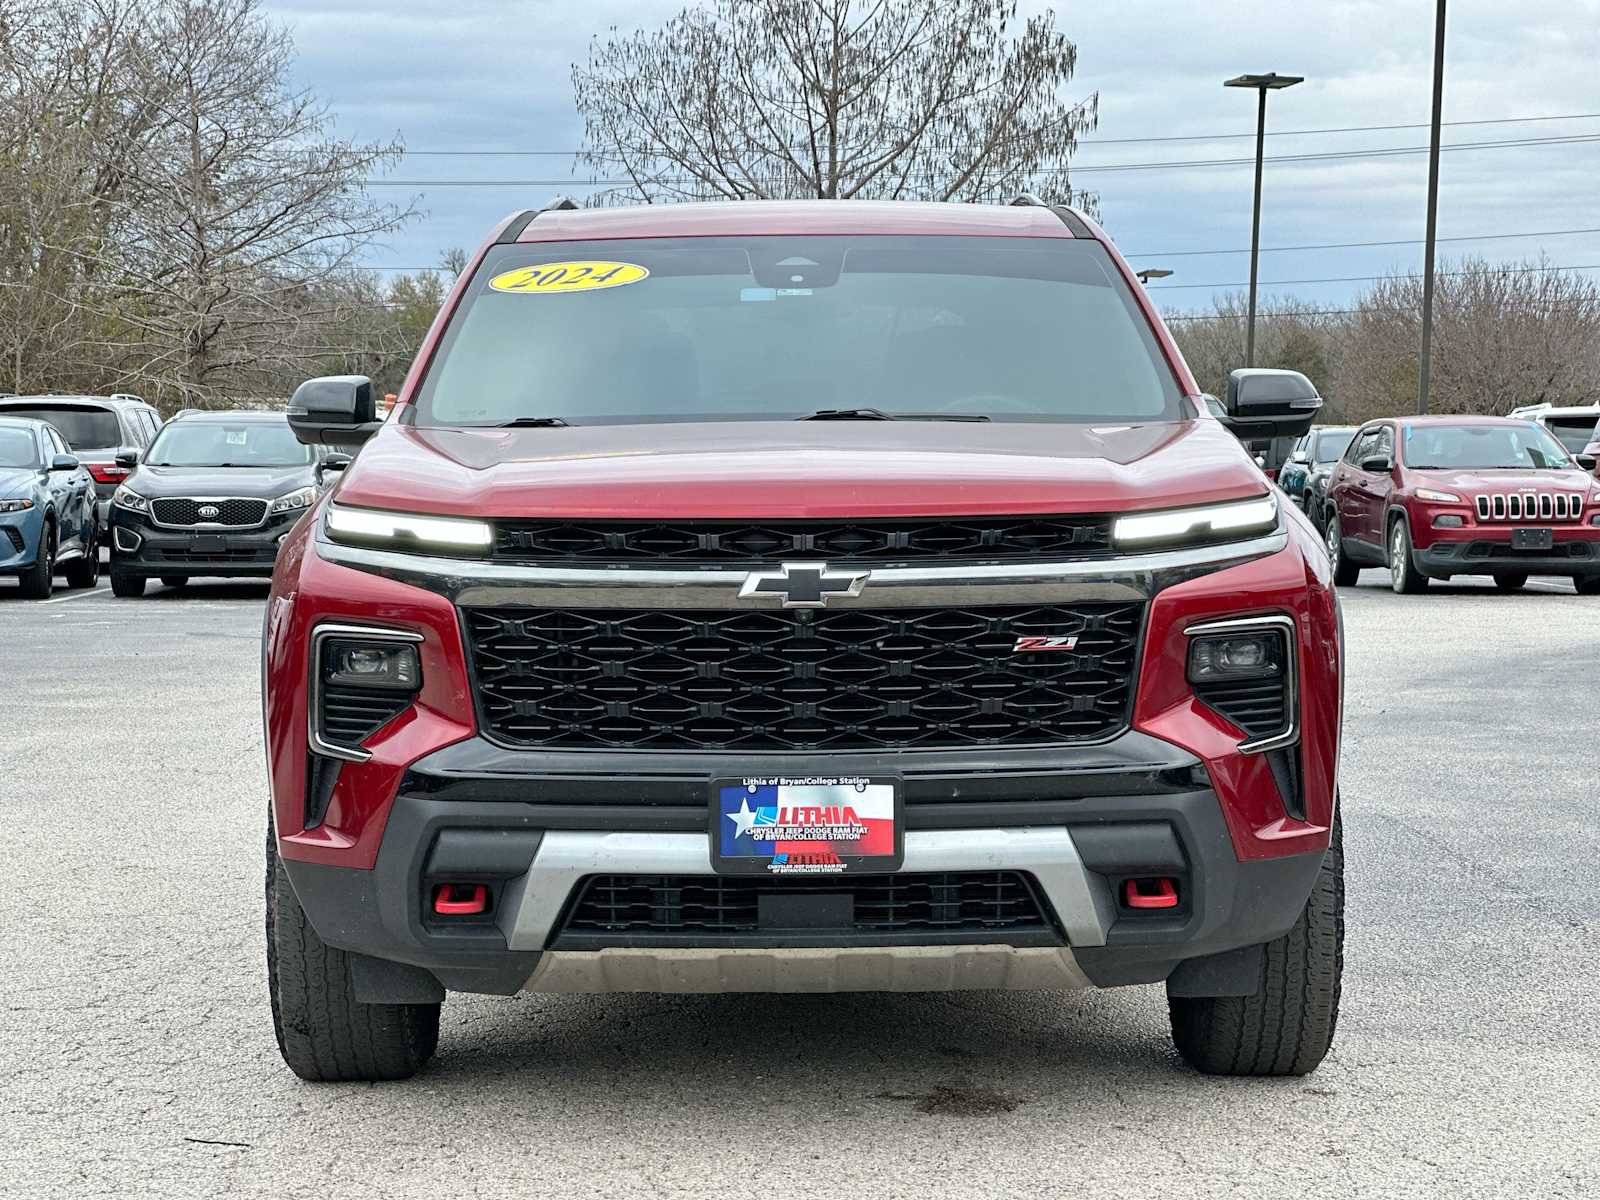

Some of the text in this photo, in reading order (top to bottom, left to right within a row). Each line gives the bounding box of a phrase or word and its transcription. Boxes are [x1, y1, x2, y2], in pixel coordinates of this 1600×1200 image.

[507, 266, 625, 289] 2024
[199, 507, 218, 516] KIA
[1013, 636, 1079, 651] Z71
[743, 777, 870, 786] Lithia of Bryan/College Station
[778, 806, 862, 826] LITHIA
[788, 853, 843, 864] LITHIA
